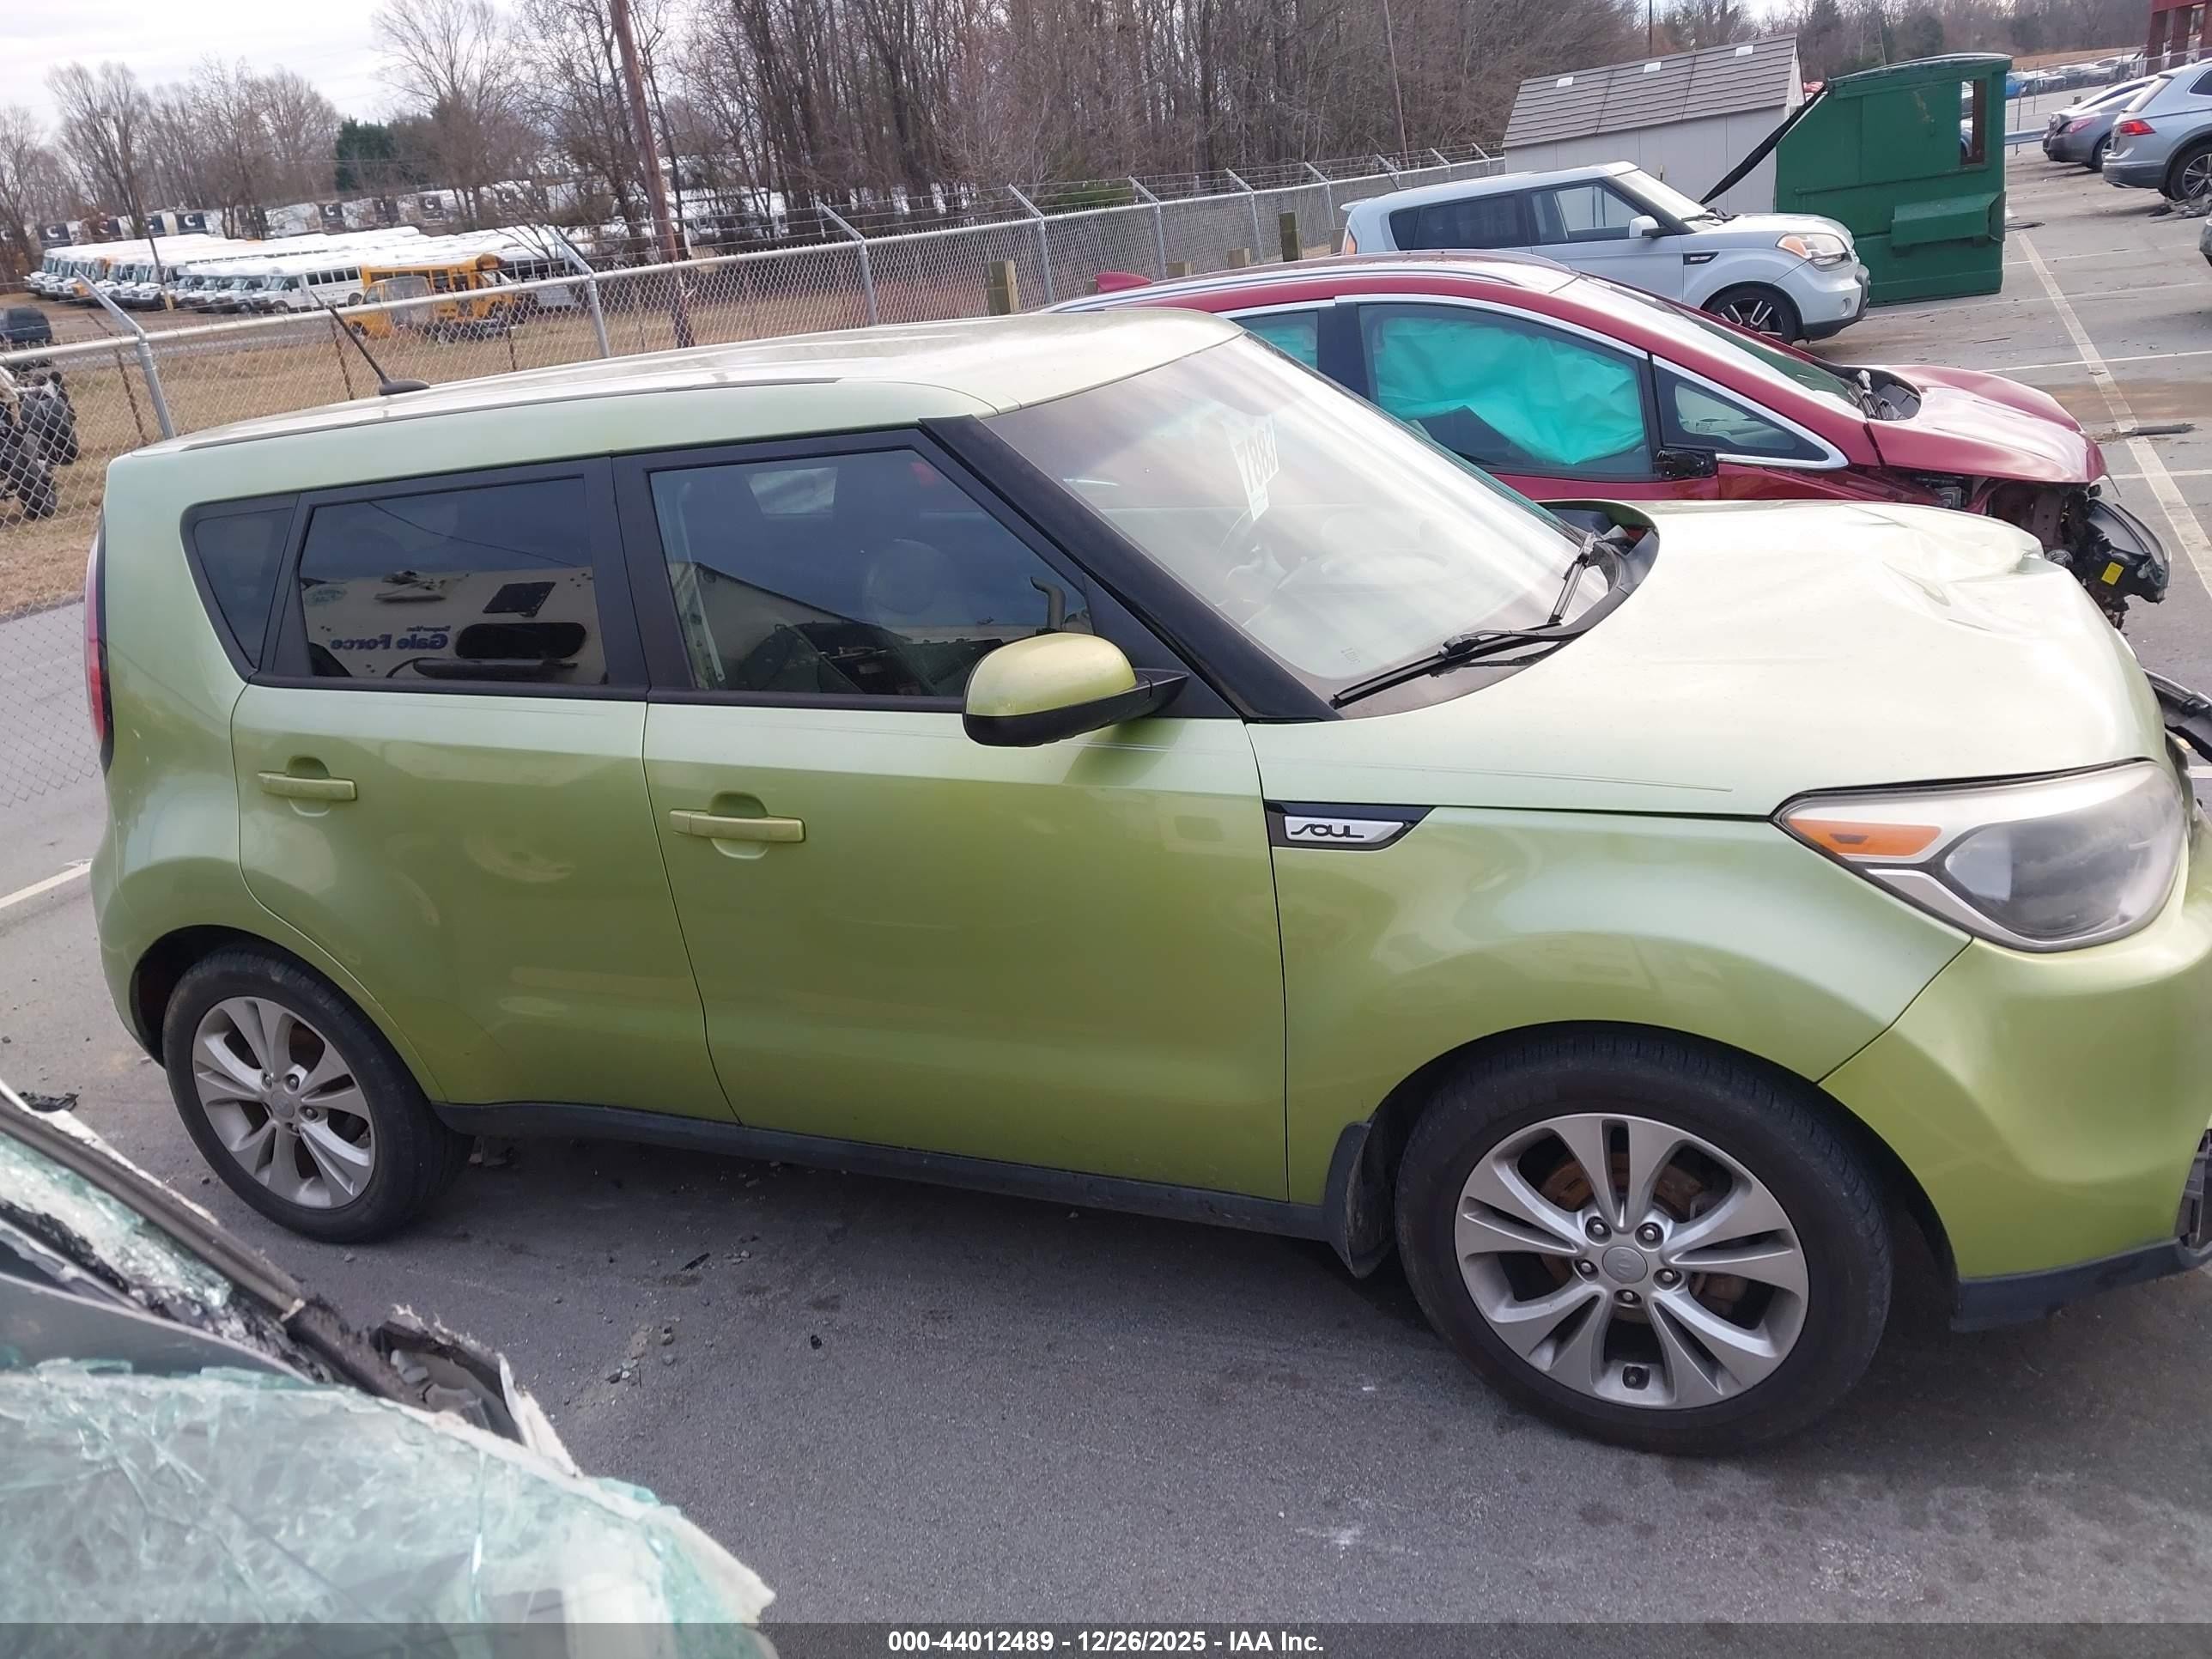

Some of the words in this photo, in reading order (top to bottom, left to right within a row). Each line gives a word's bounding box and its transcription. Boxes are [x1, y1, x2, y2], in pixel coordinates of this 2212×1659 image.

[325, 204, 336, 216] C
[184, 215, 197, 227] C
[46, 225, 59, 238] C
[1291, 823, 1364, 838] SOUL
